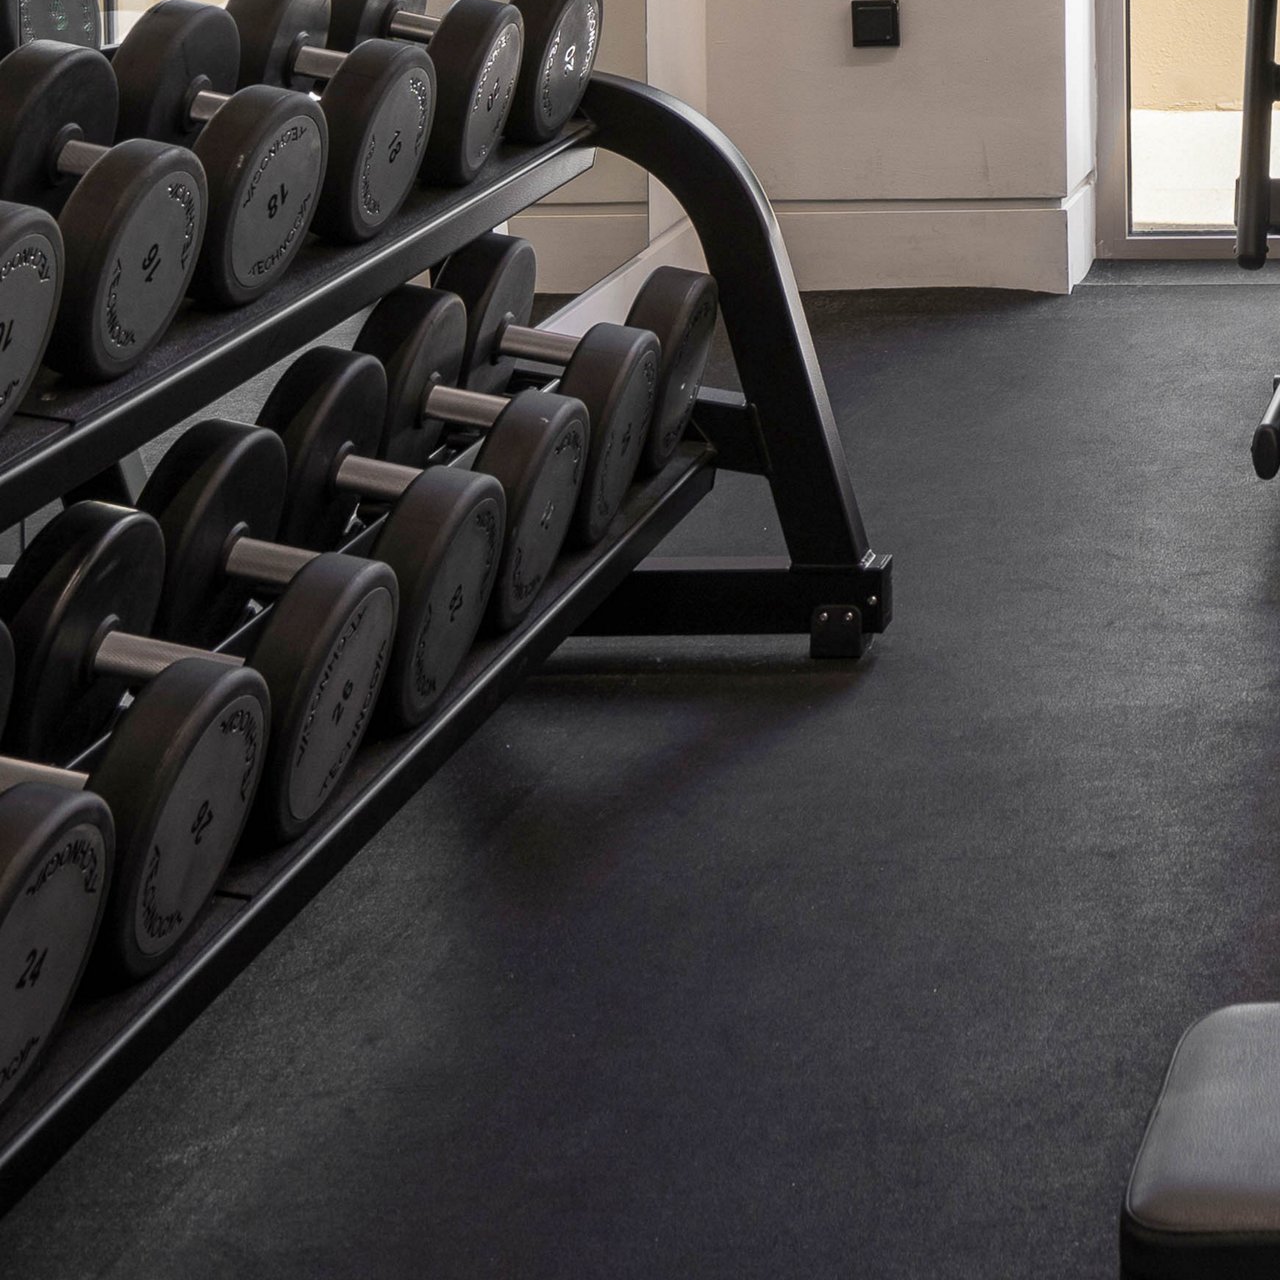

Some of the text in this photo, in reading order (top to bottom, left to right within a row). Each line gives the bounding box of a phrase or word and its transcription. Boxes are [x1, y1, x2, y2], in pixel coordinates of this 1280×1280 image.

[388, 130, 402, 164] 18
[266, 182, 290, 220] 18
[141, 242, 163, 283] 16
[331, 677, 354, 727] 26
[190, 799, 215, 847] 26
[14, 946, 49, 990] 24
